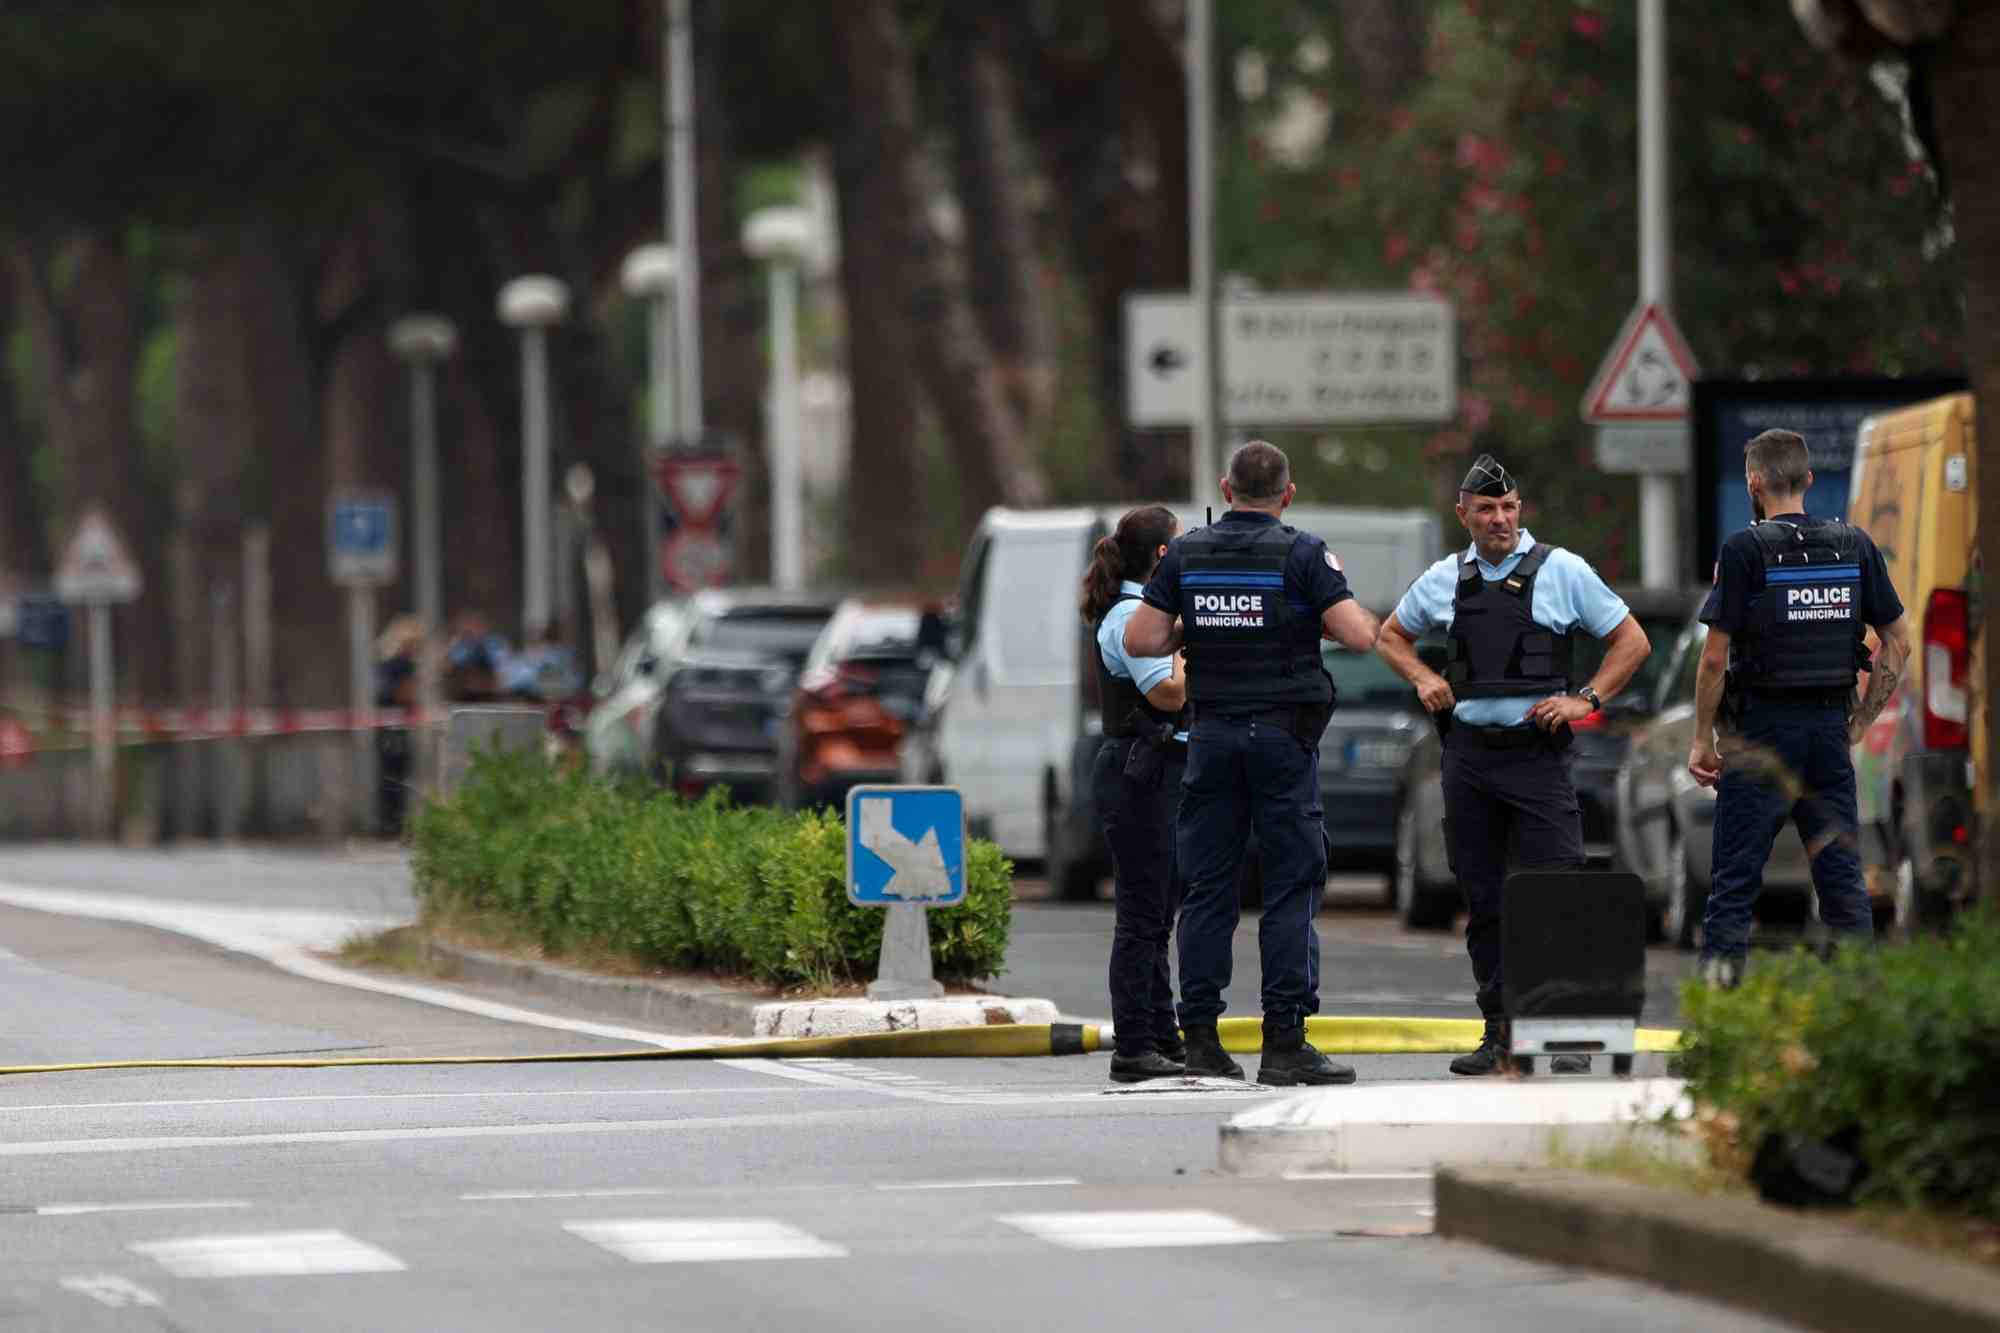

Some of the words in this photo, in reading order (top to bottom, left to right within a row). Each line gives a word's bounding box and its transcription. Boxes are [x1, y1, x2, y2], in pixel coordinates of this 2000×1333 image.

[1194, 595, 1263, 611] POLICE
[1787, 587, 1851, 605] POLICE
[1195, 616, 1265, 627] MUNICIPALE
[1788, 608, 1851, 621] MUNICIPALE
